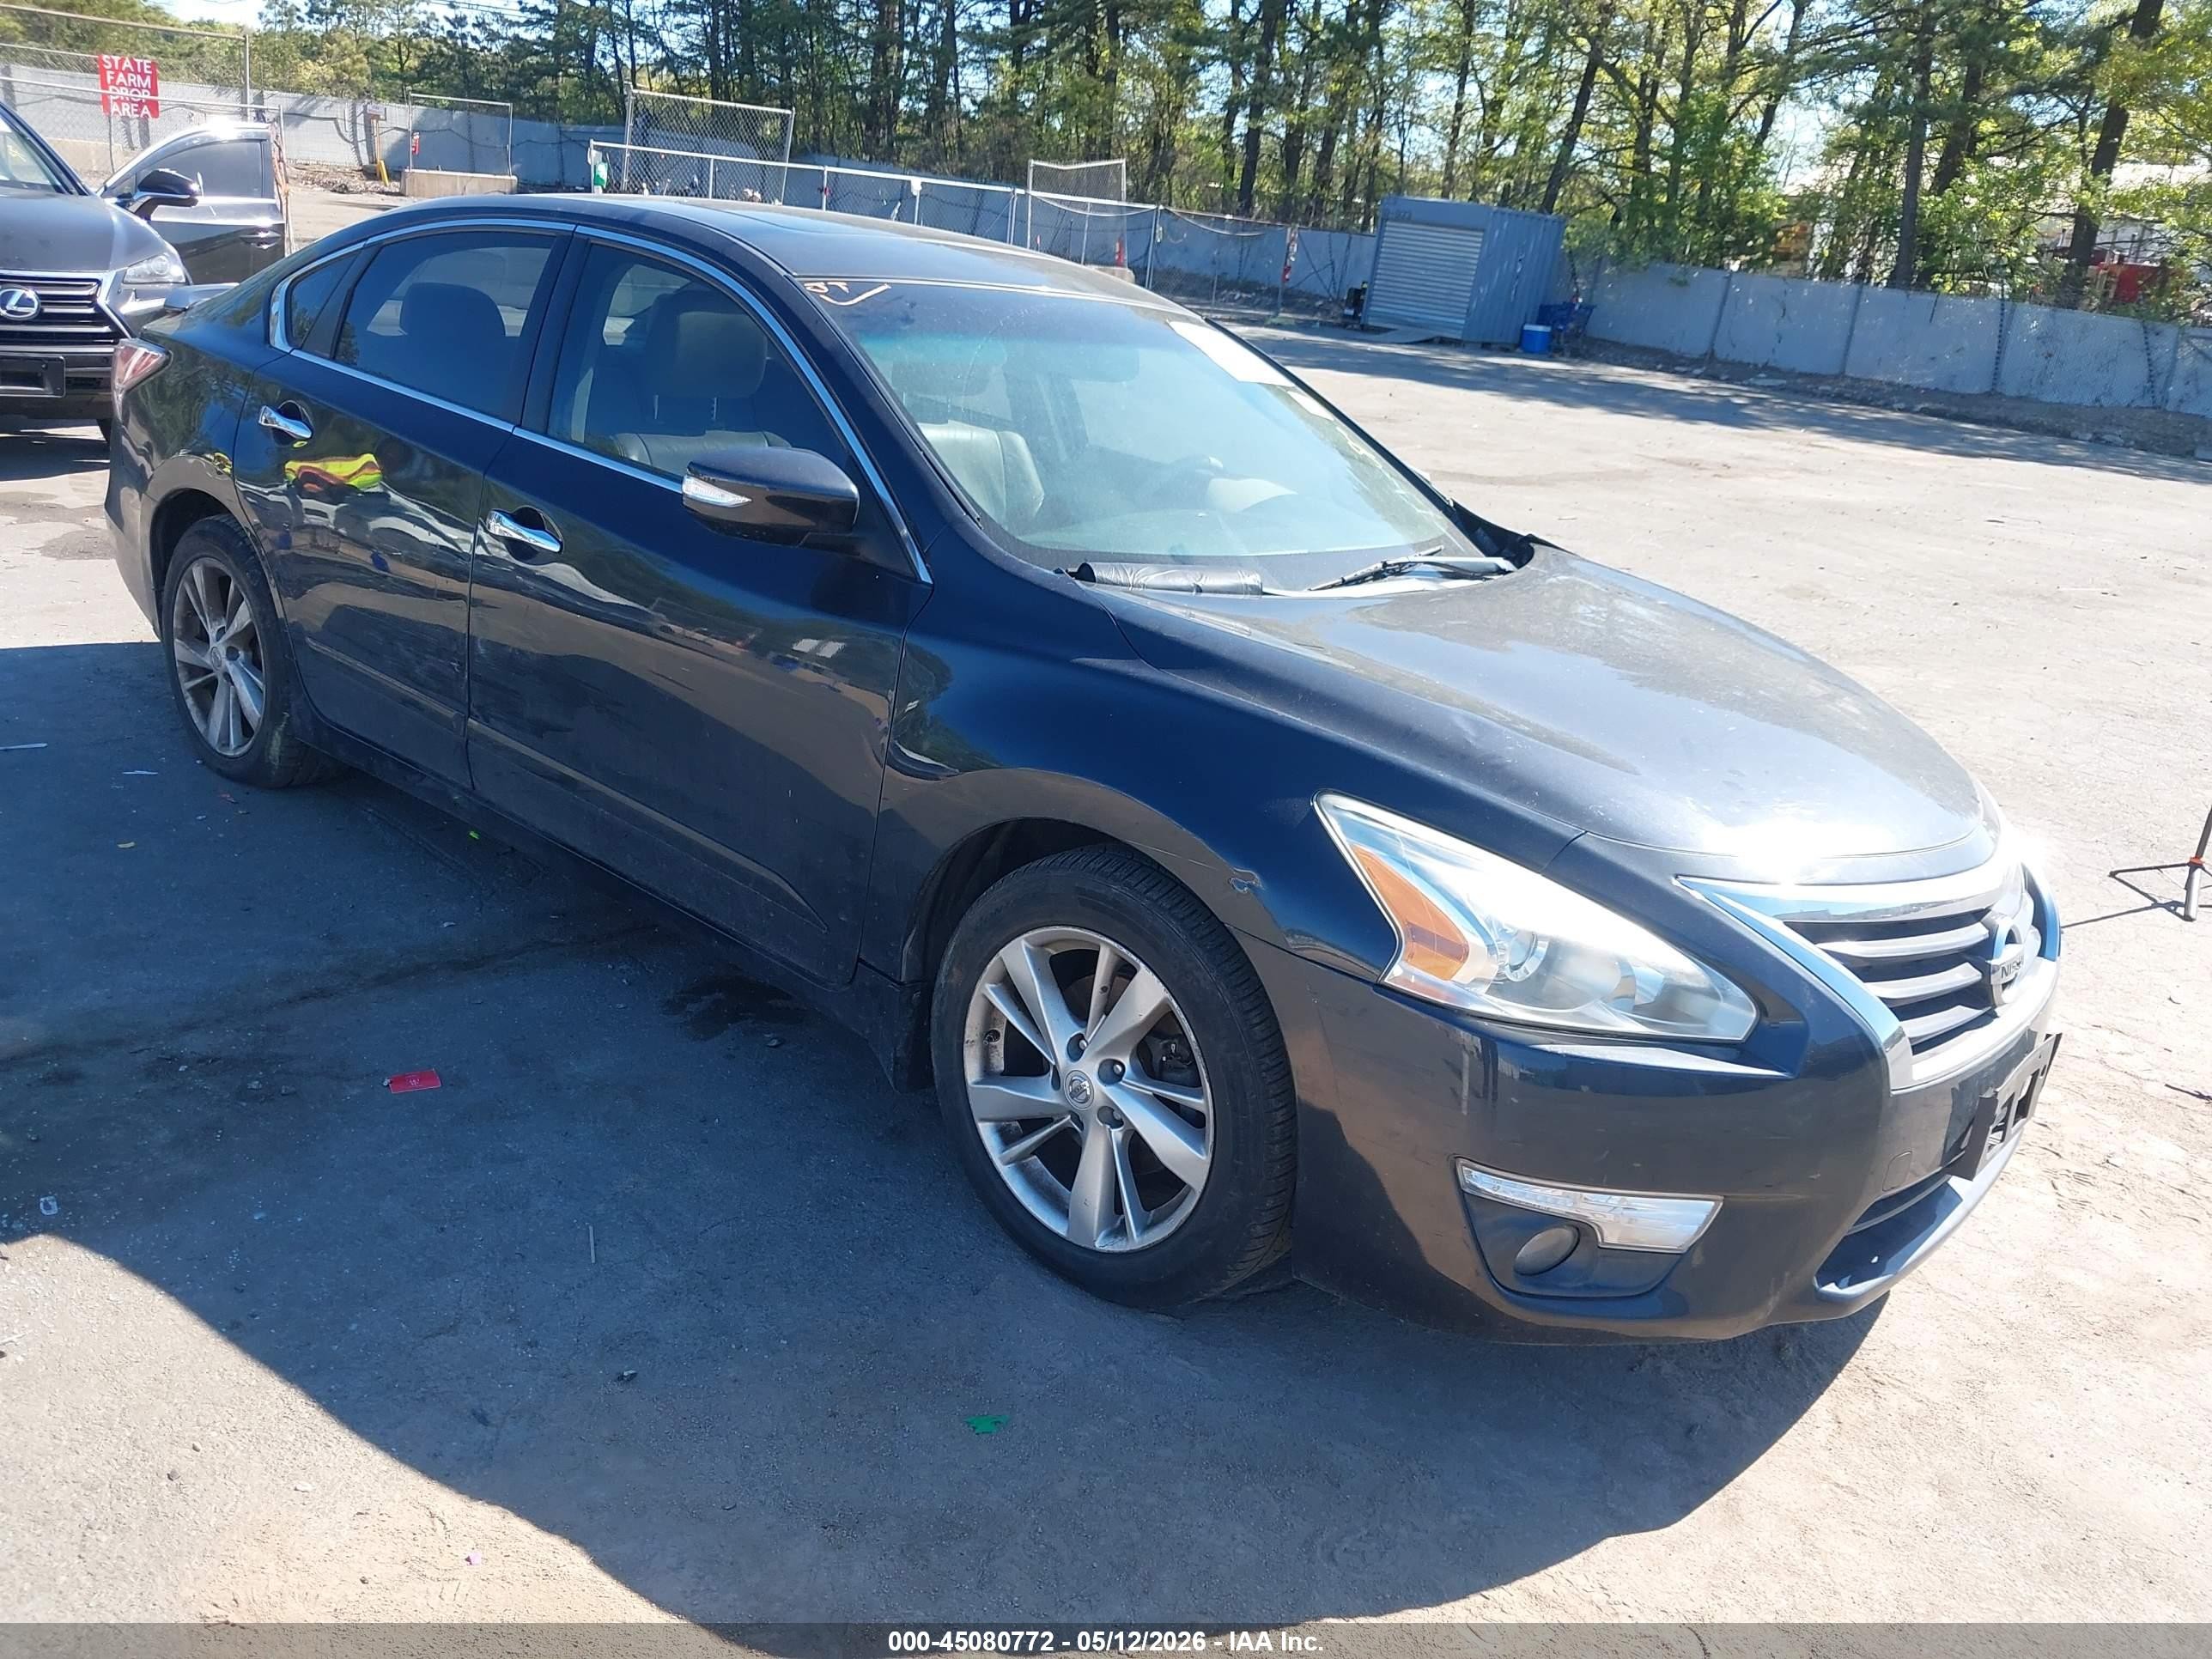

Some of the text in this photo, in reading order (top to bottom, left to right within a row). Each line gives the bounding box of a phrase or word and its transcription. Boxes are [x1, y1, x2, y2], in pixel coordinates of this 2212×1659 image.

[102, 55, 152, 75] STATE
[106, 70, 151, 88] FARM
[108, 85, 150, 103] DROP
[111, 101, 152, 118] AREA
